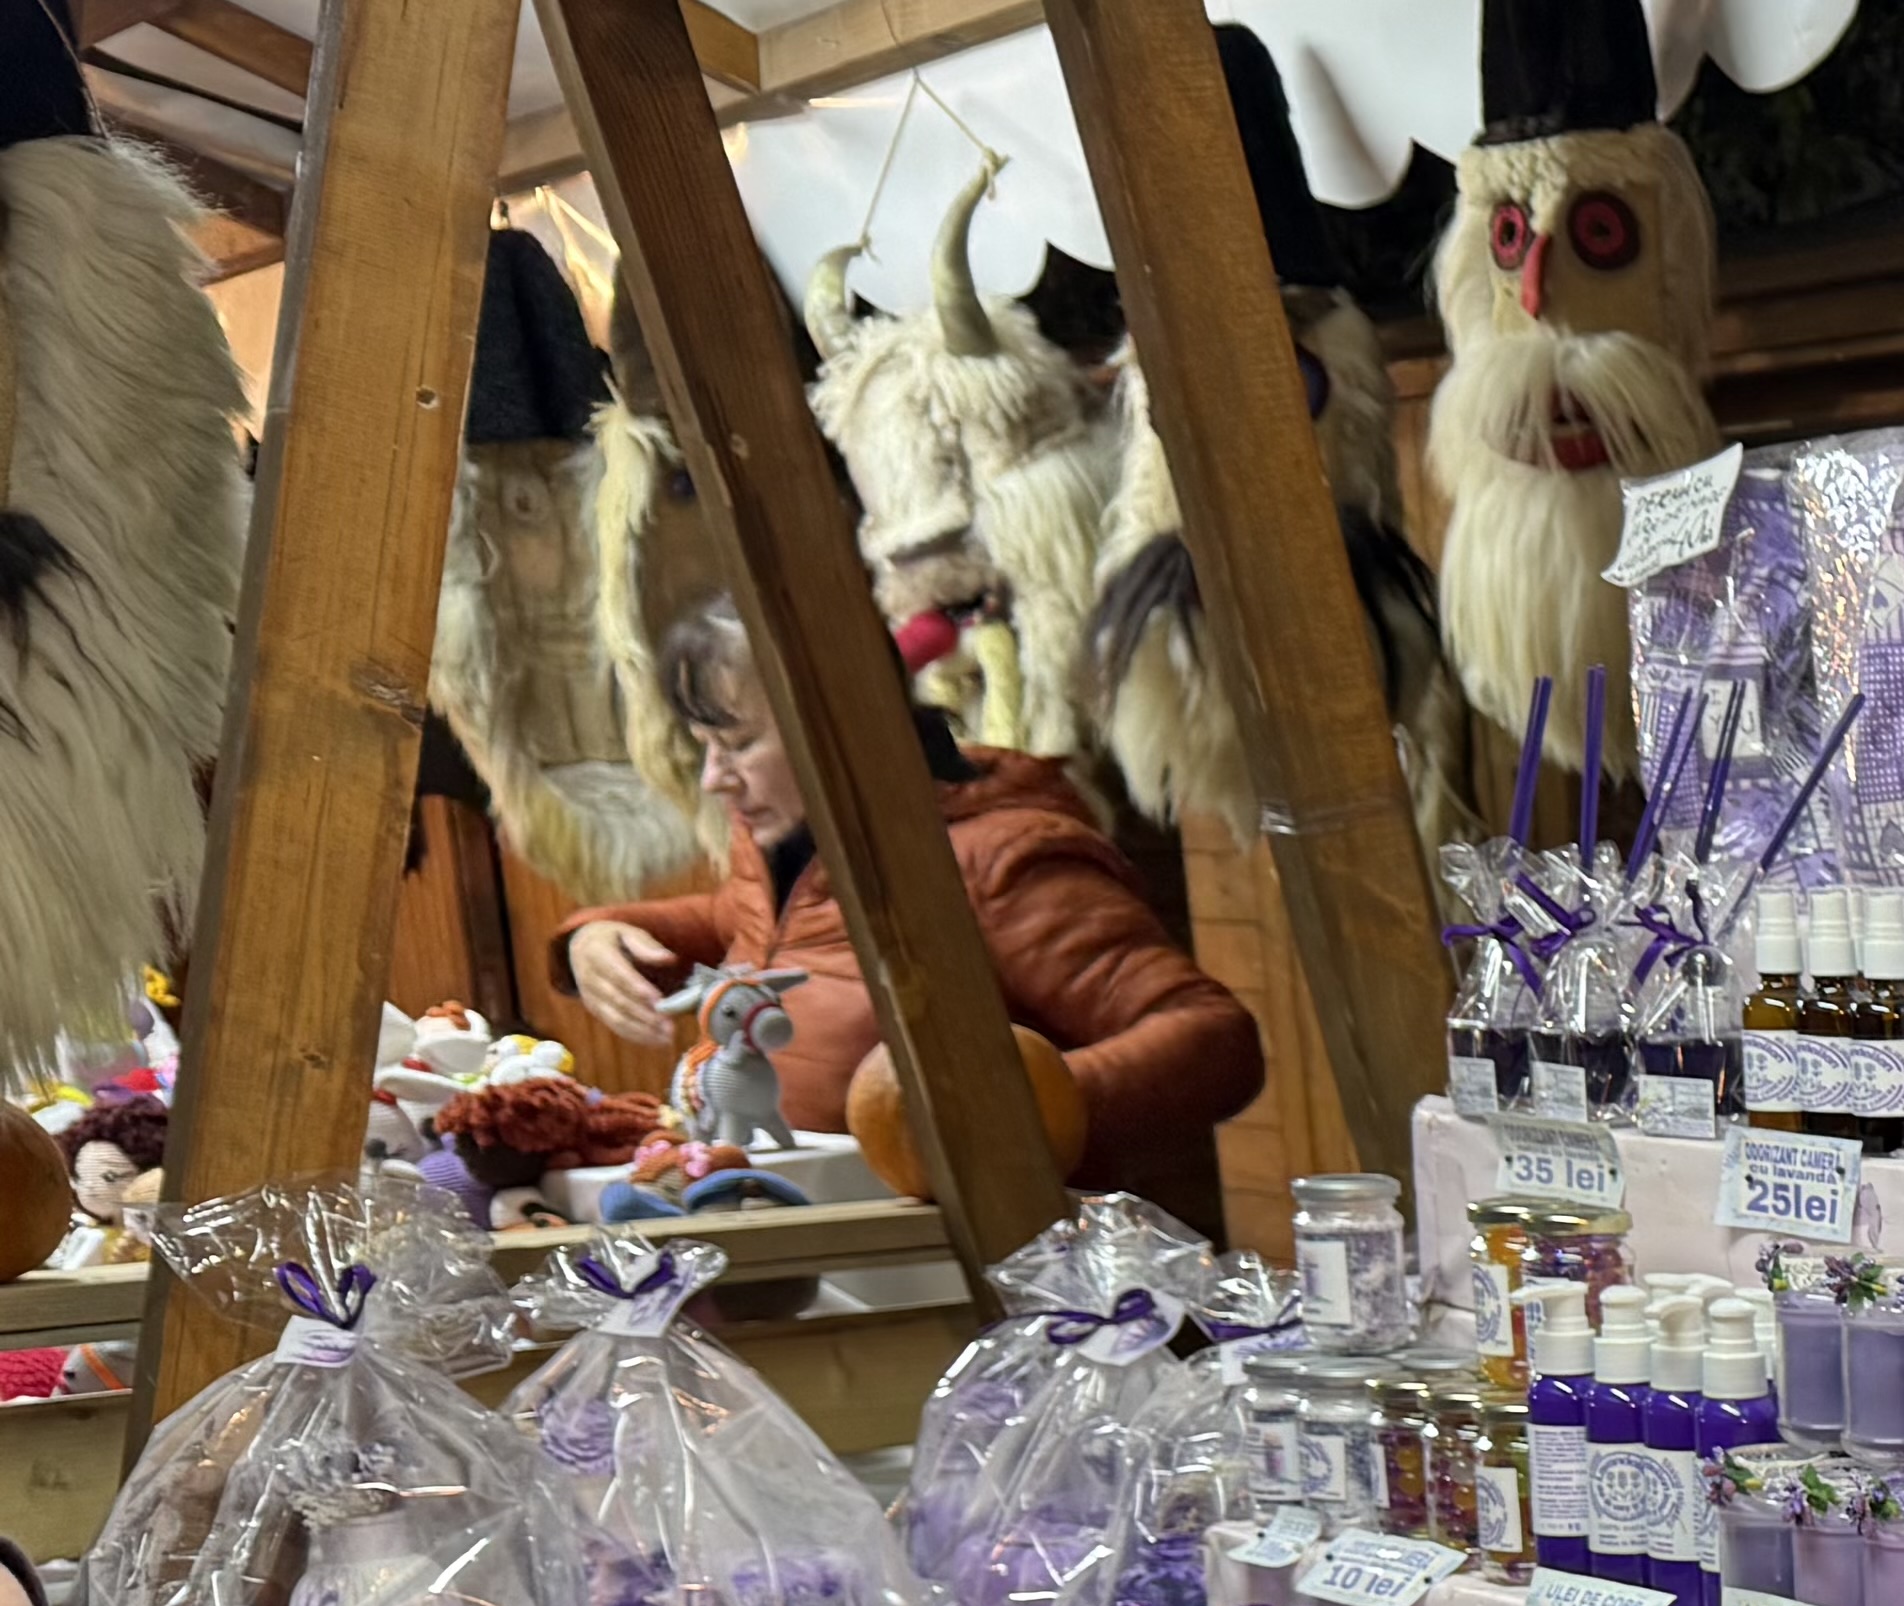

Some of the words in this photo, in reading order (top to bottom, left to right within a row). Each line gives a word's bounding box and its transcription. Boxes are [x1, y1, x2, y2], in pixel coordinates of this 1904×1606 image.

[1516, 1153, 1553, 1185] 35
[1566, 1158, 1605, 1193] lei
[1751, 1163, 1768, 1175] cu
[1772, 1163, 1837, 1185] lavandă
[1748, 1179, 1839, 1226] 25lei
[1323, 1565, 1363, 1590] 10
[1366, 1572, 1412, 1597] lei
[1581, 1590, 1597, 1606] DE
